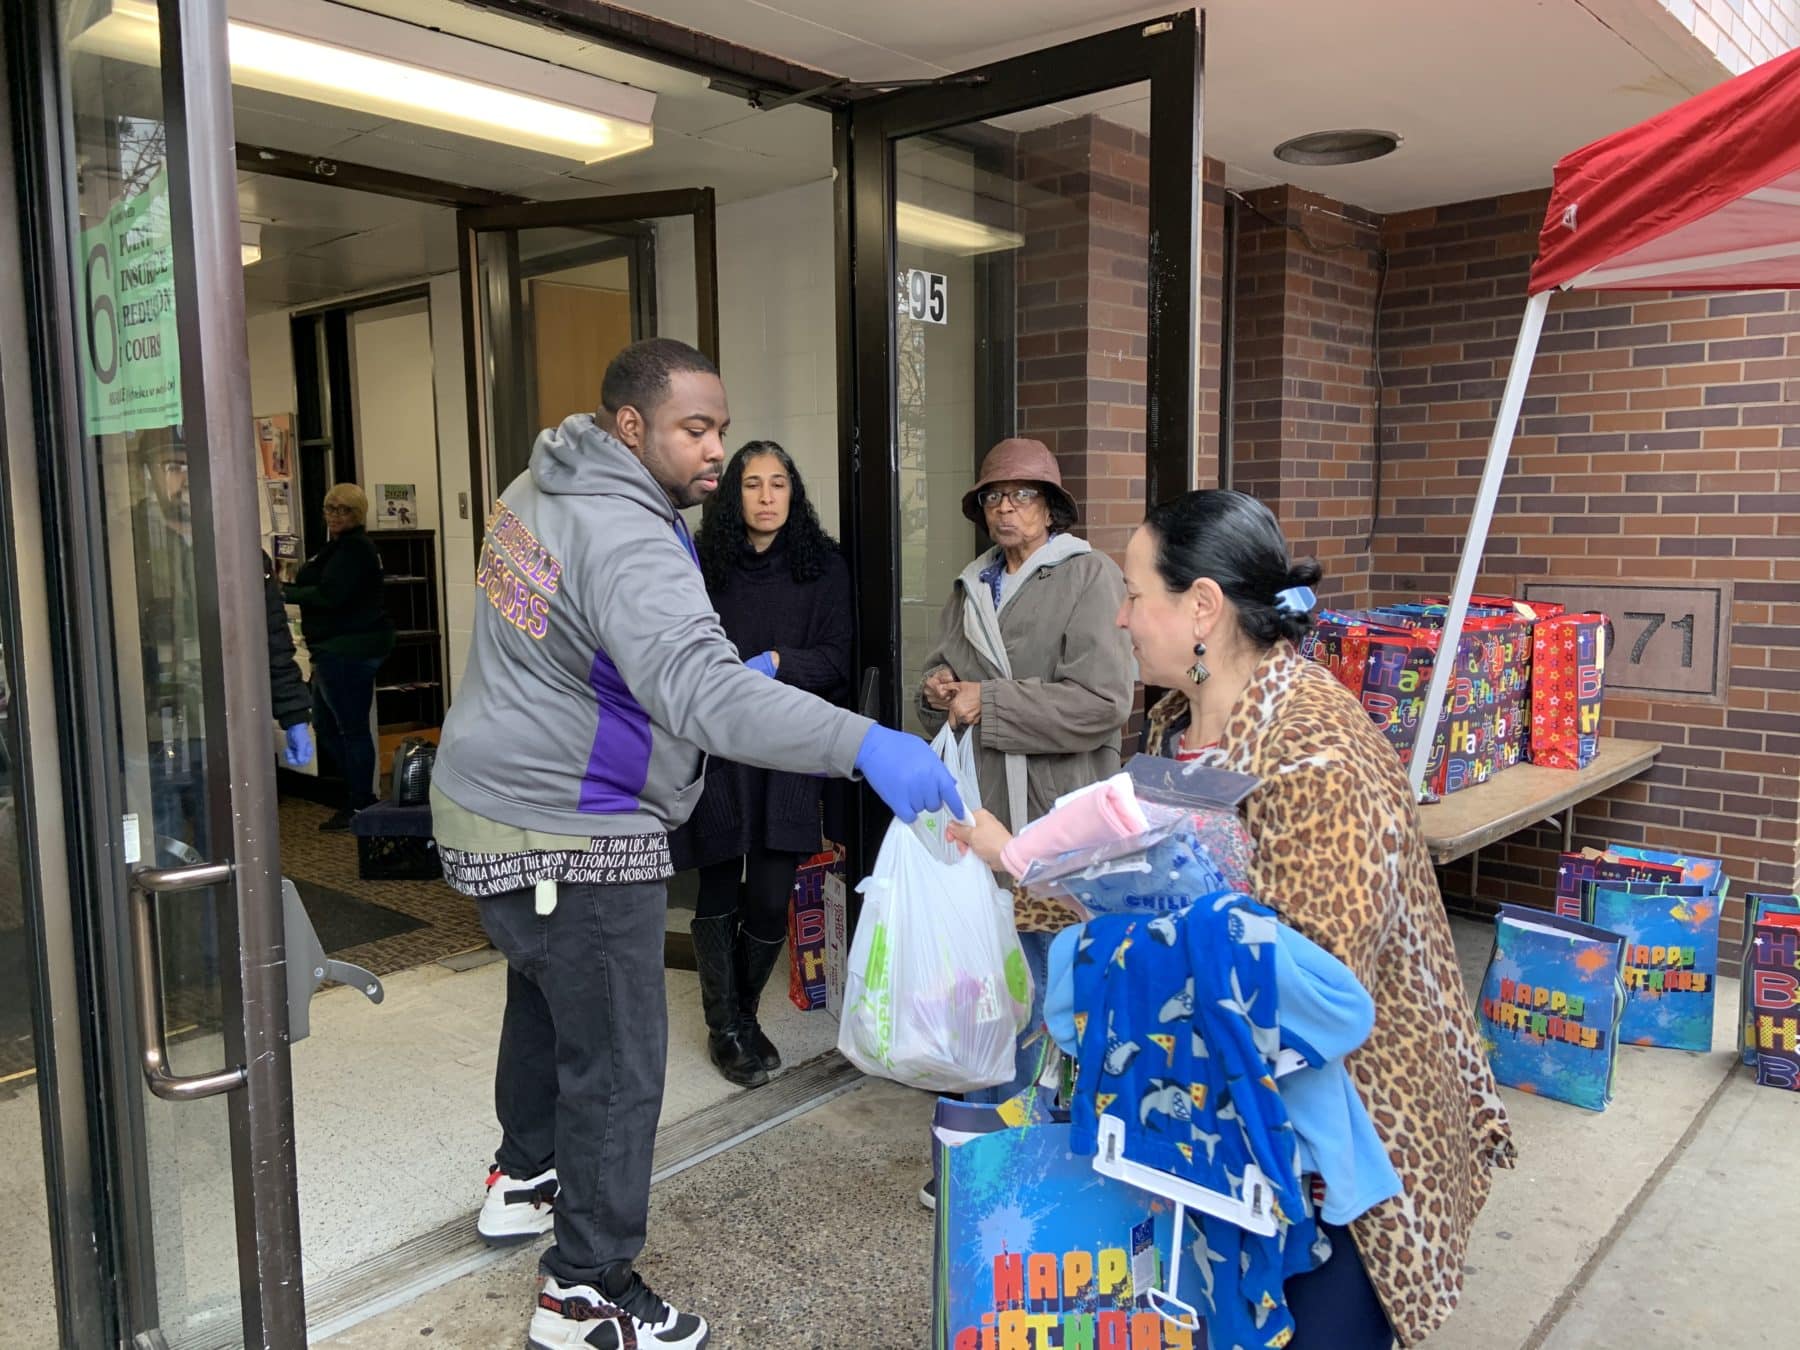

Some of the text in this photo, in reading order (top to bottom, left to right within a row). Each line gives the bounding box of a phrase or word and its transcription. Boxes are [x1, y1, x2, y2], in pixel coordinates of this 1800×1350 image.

[86, 243, 118, 385] 6
[1604, 610, 1694, 669] 71
[1500, 978, 1585, 1019] HAPPY
[993, 1247, 1162, 1304] HAPP
